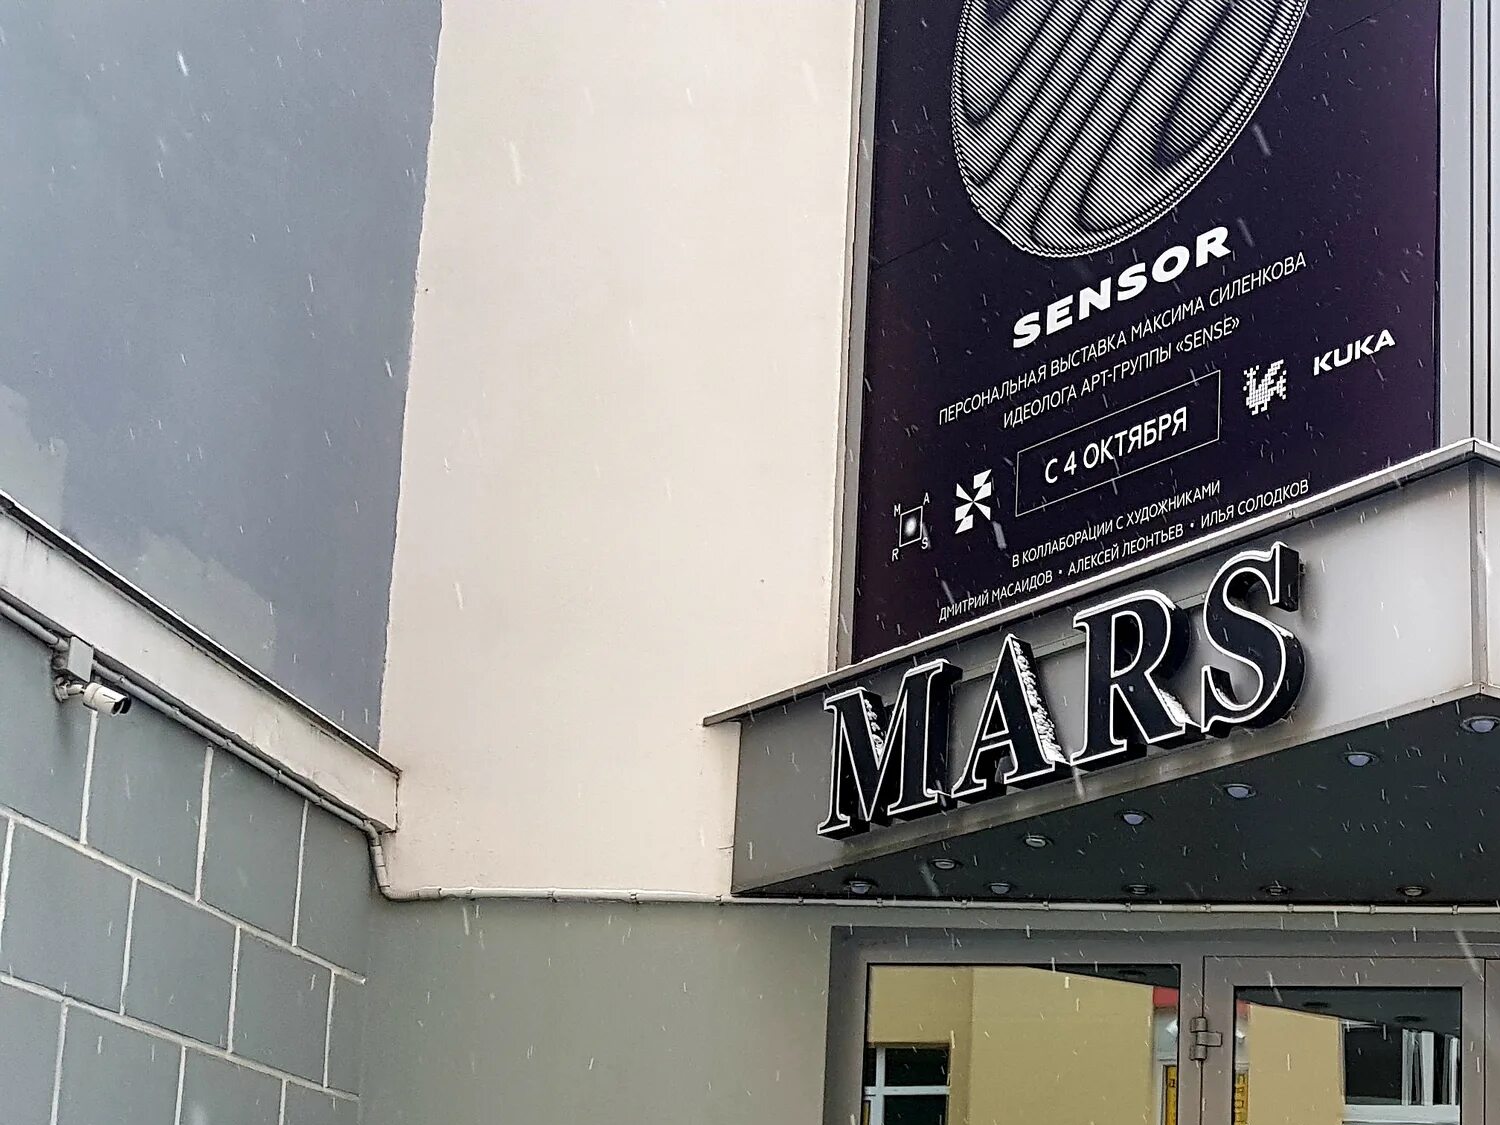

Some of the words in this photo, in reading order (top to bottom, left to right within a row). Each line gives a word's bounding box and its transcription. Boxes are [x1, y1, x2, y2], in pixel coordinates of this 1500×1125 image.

[938, 364, 1048, 426] ПЕРСОНАЛЬНАЯ
[1050, 335, 1127, 379] ВЫСТАВКА
[1131, 297, 1206, 341] МАКСИМА
[1209, 252, 1308, 303] СИЛЕНКОВА
[1012, 226, 1232, 349] SENSOR
[1003, 387, 1077, 429] ИДЕОЛОГА
[1080, 350, 1172, 398] АРТ-ГРУППЫ
[1175, 317, 1240, 356] «SENSE»
[1313, 328, 1396, 376] KUKA
[1044, 458, 1058, 485] С
[1063, 451, 1078, 475] 4
[1083, 408, 1187, 468] ОКТЯБРЯ
[939, 589, 990, 623] ДМИТРИЙ
[992, 570, 1053, 600] МАСАИДОВ
[1068, 545, 1121, 577] АЛЕКСЕЙ
[1122, 523, 1184, 558] ЛЕОНТЬЕВ
[1201, 506, 1235, 530] ИЛЬЯ
[1237, 479, 1309, 514] СОЛОДКОВ
[1012, 552, 1020, 567] В
[1022, 518, 1113, 564] КОЛЛАБОРАЦИИ
[1126, 480, 1221, 530] ХУДОЖНИКАМИ
[818, 541, 1303, 838] MARS
